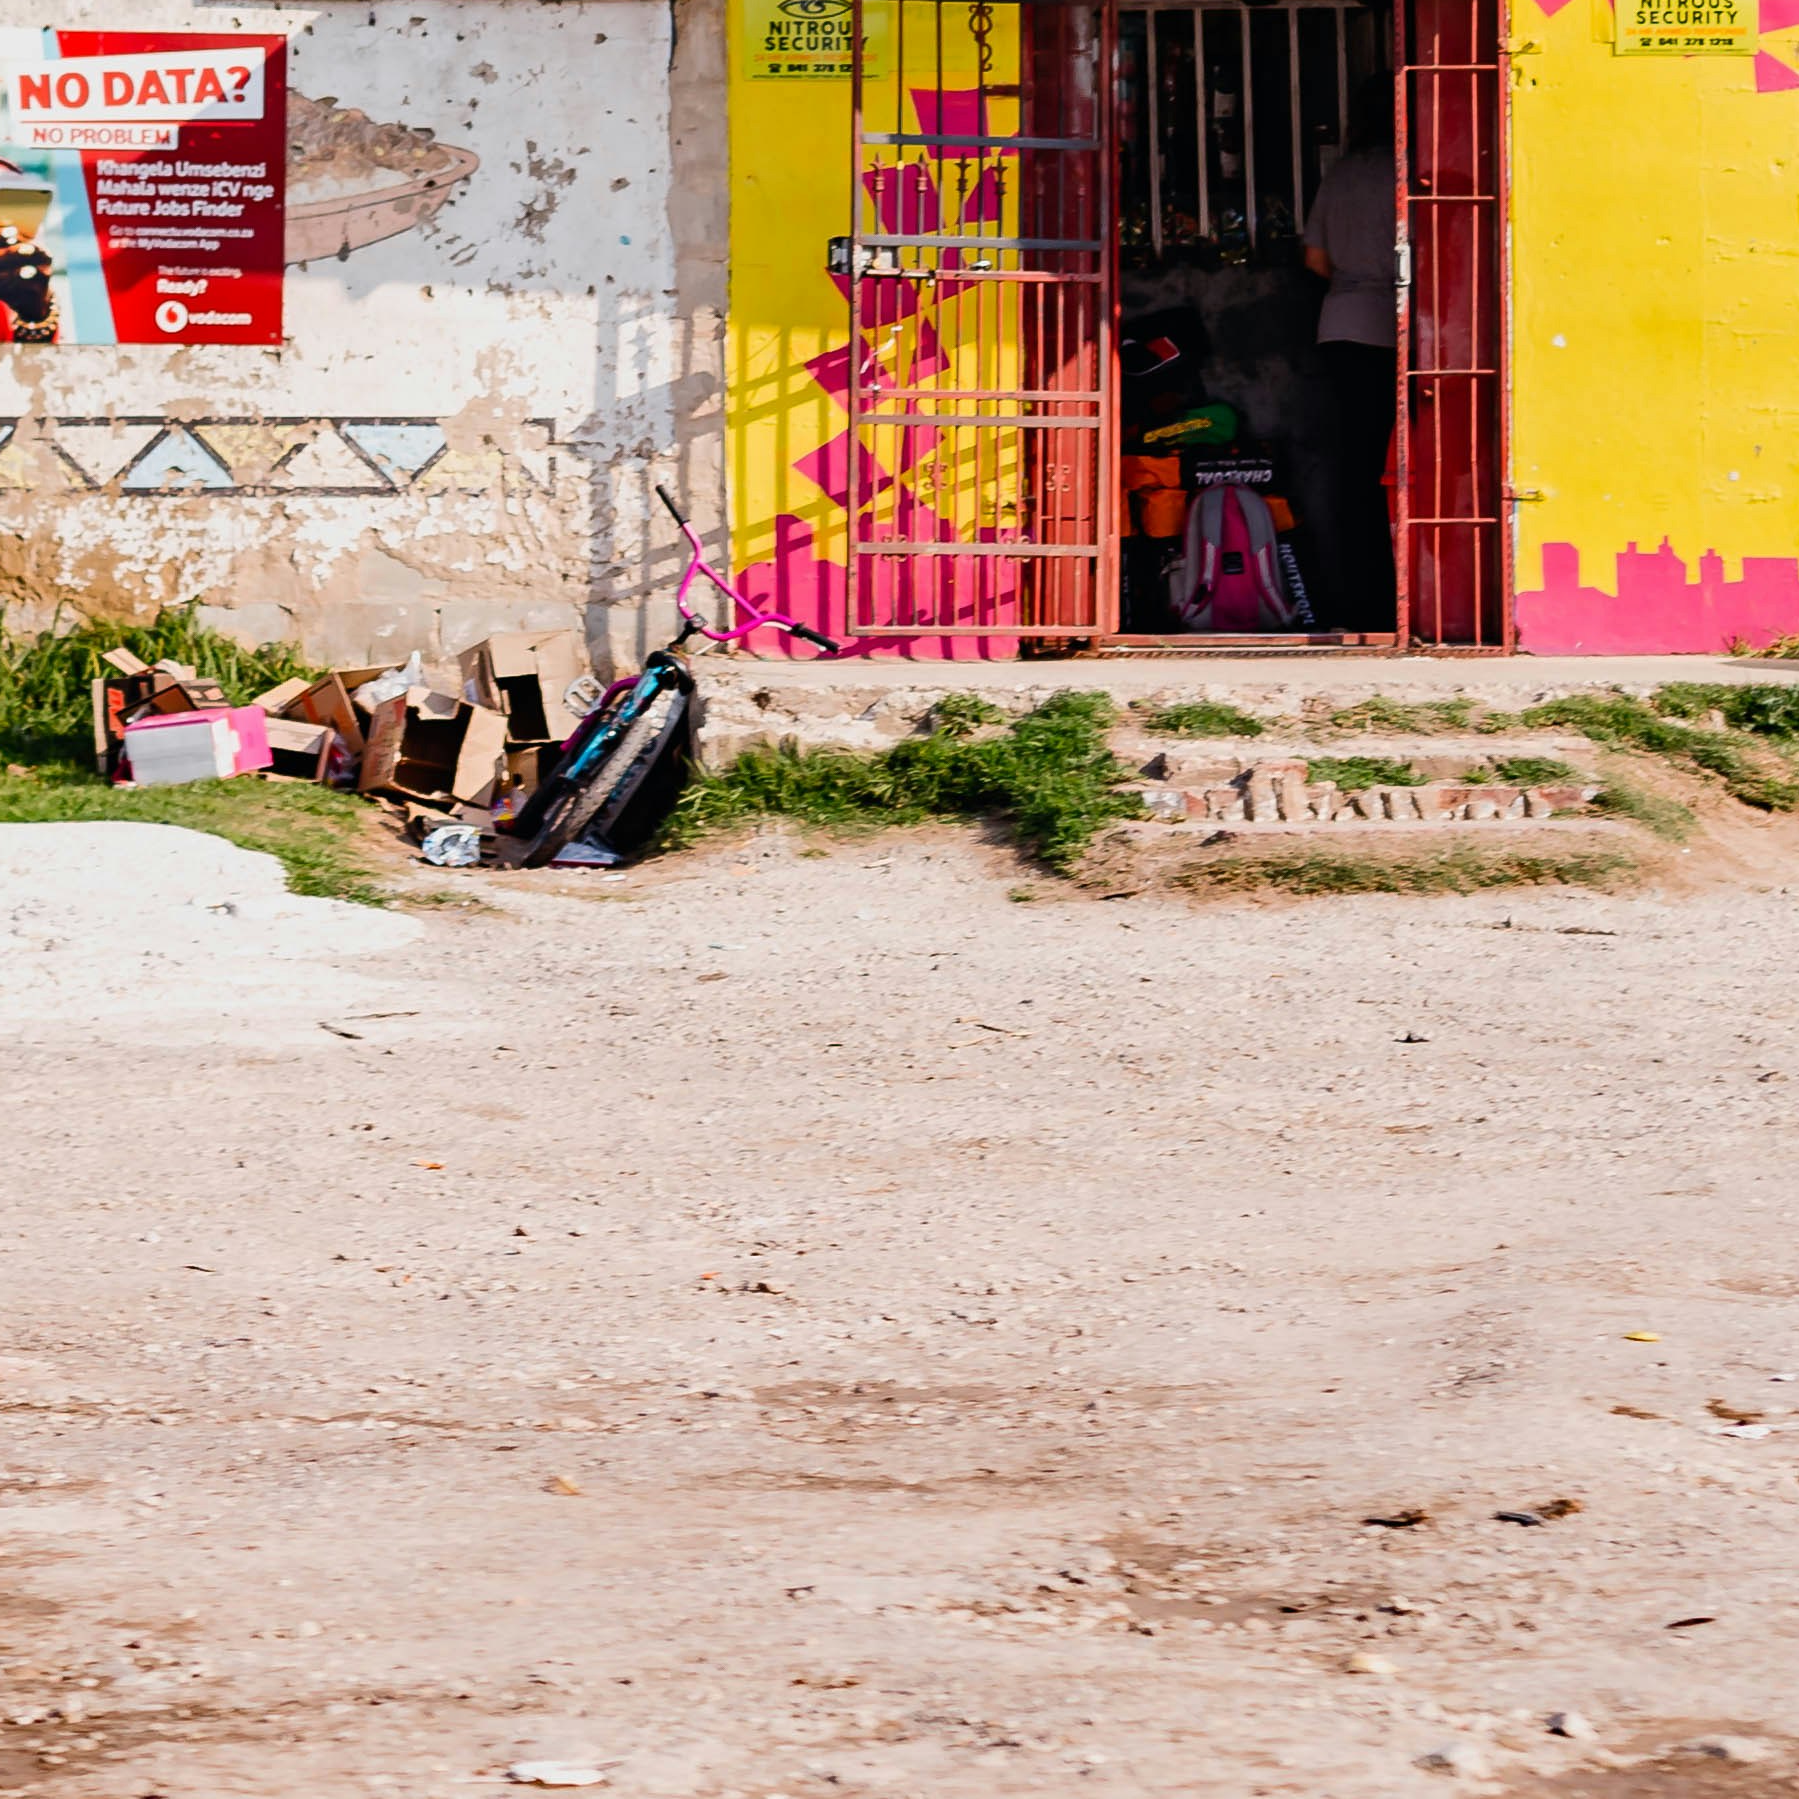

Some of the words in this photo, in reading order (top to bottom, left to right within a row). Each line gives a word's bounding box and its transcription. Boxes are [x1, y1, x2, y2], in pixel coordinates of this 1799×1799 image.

[1636, 11, 1738, 25] SECURITY
[769, 21, 853, 35] NITROU
[18, 72, 90, 110] NO
[102, 65, 252, 107] DATA?
[33, 127, 63, 143] NO
[70, 127, 171, 145] PROBLEM
[96, 160, 173, 180] Khangela
[175, 161, 267, 179] Umsebenzi
[96, 180, 156, 196] Mahala
[158, 183, 209, 197] wenze
[211, 181, 242, 197] iCV
[242, 185, 275, 202] nge
[96, 199, 150, 215] Future
[152, 200, 190, 217] Jobs
[192, 200, 245, 217] Finder
[188, 310, 253, 325] vodacom
